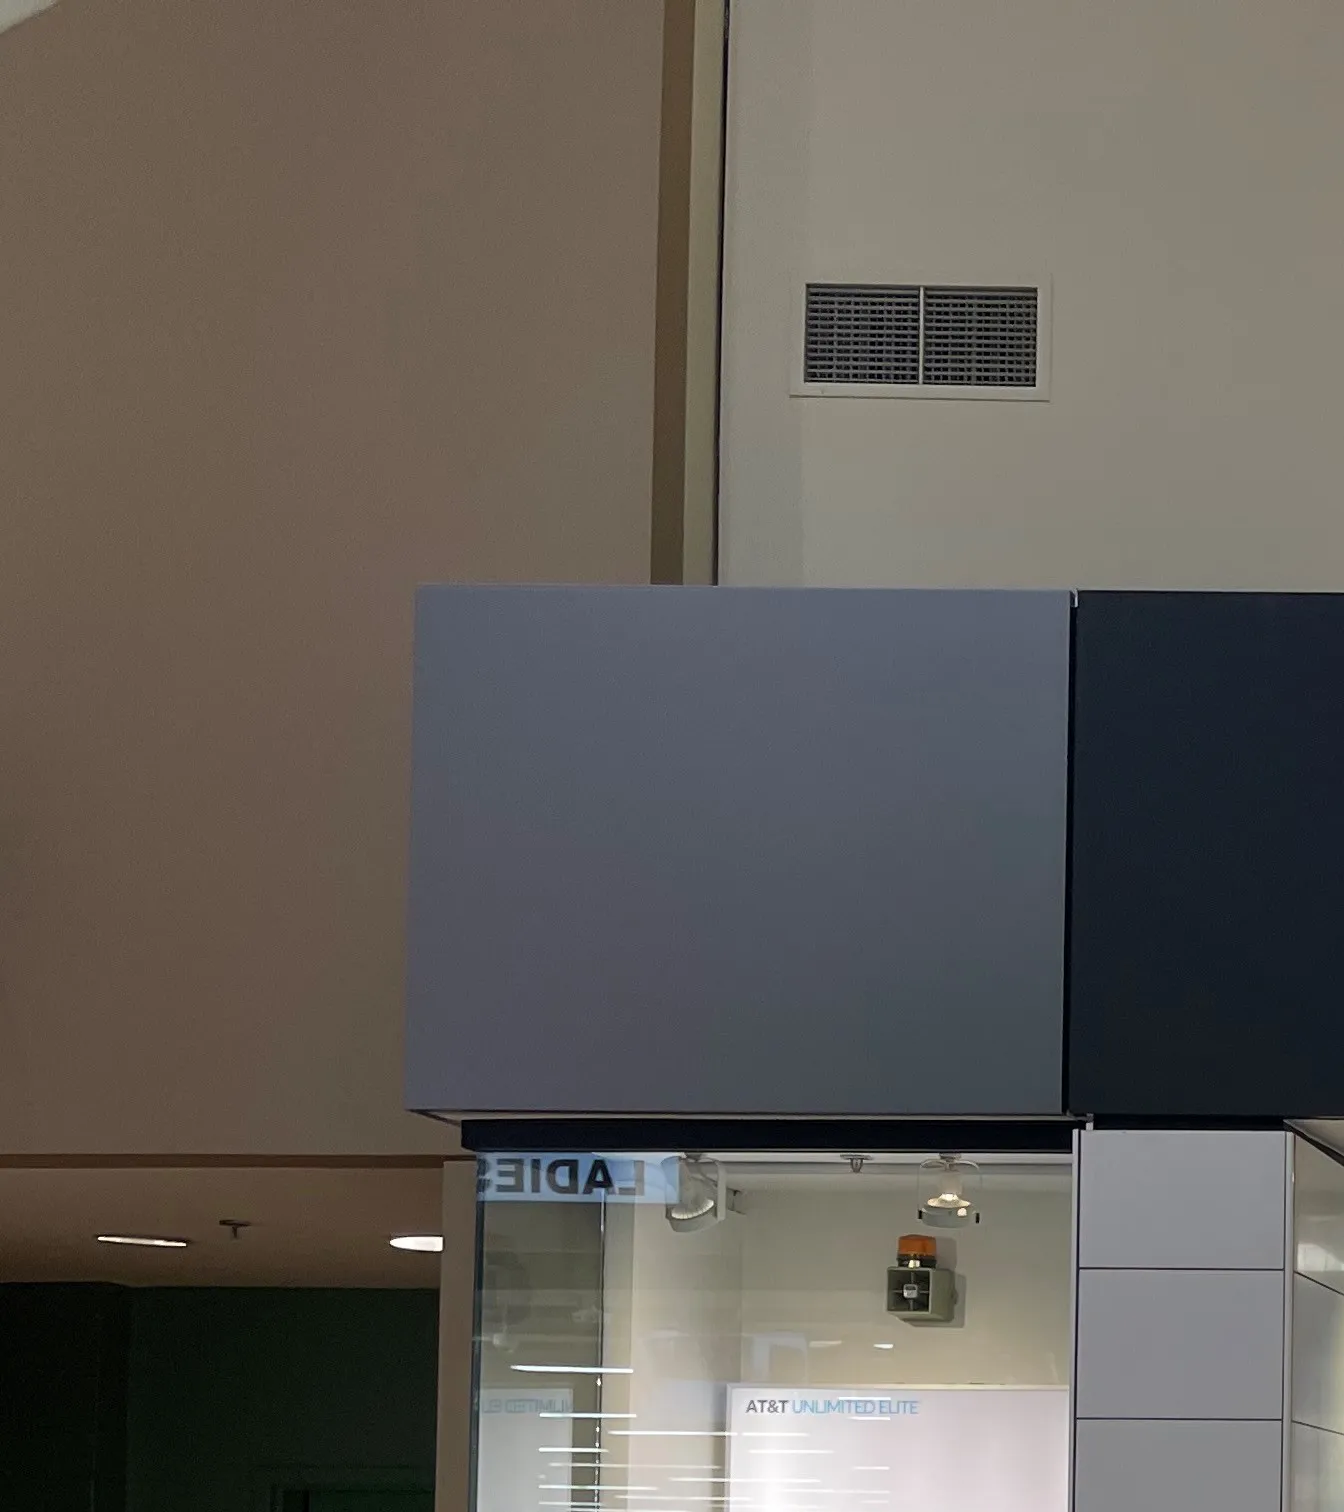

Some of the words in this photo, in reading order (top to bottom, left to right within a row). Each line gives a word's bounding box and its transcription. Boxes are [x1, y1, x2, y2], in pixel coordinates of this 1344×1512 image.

[745, 1400, 788, 1415] AT&T
[792, 1400, 876, 1415] UNLIMITED
[878, 1400, 920, 1415] ELITE
